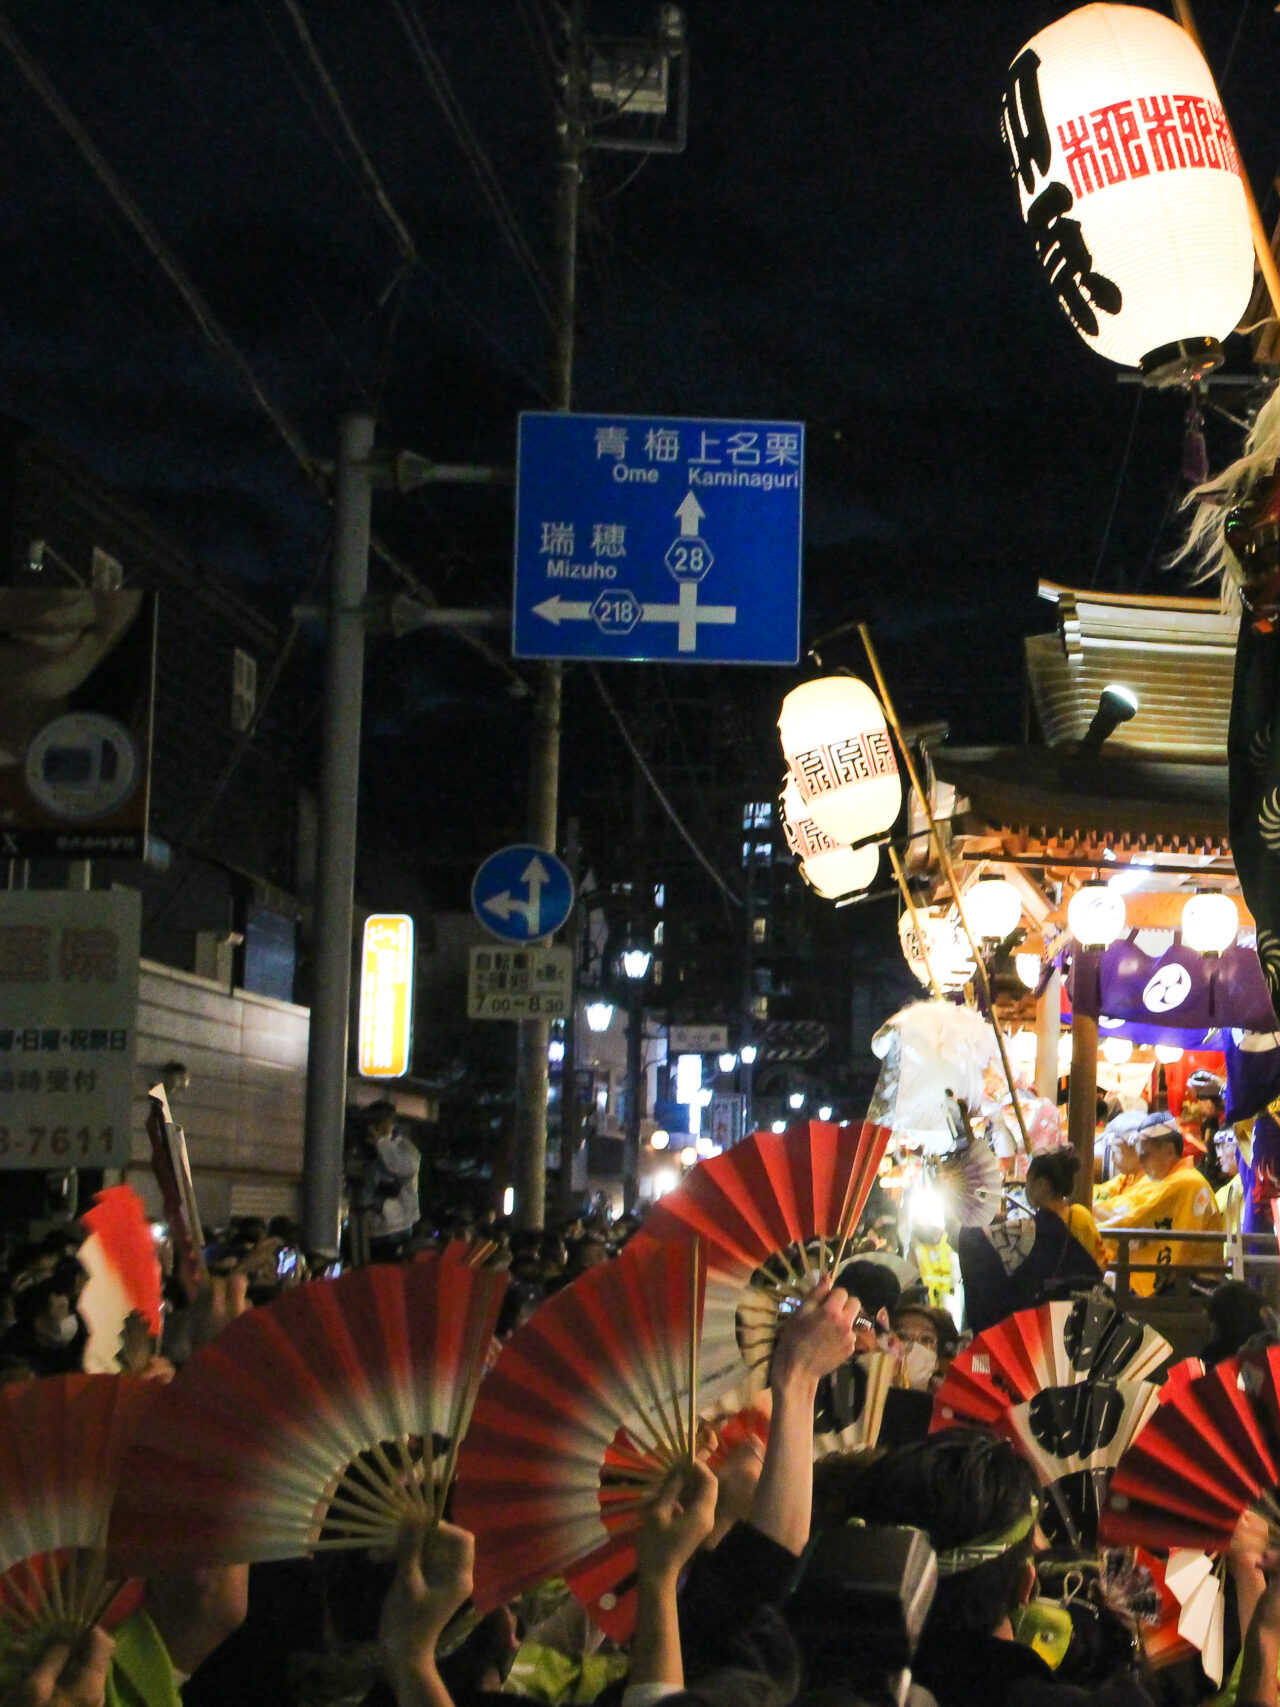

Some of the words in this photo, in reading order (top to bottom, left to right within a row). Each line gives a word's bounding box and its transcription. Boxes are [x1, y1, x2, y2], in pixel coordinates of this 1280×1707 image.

[595, 426, 680, 463] 青梅
[687, 430, 800, 466] 上名栗
[613, 464, 659, 483] Ome
[688, 467, 799, 491] Kaminaguri
[539, 521, 627, 557] 瑞穂
[547, 561, 617, 579] Mizuho
[674, 547, 704, 572] 28
[599, 602, 633, 623] 218
